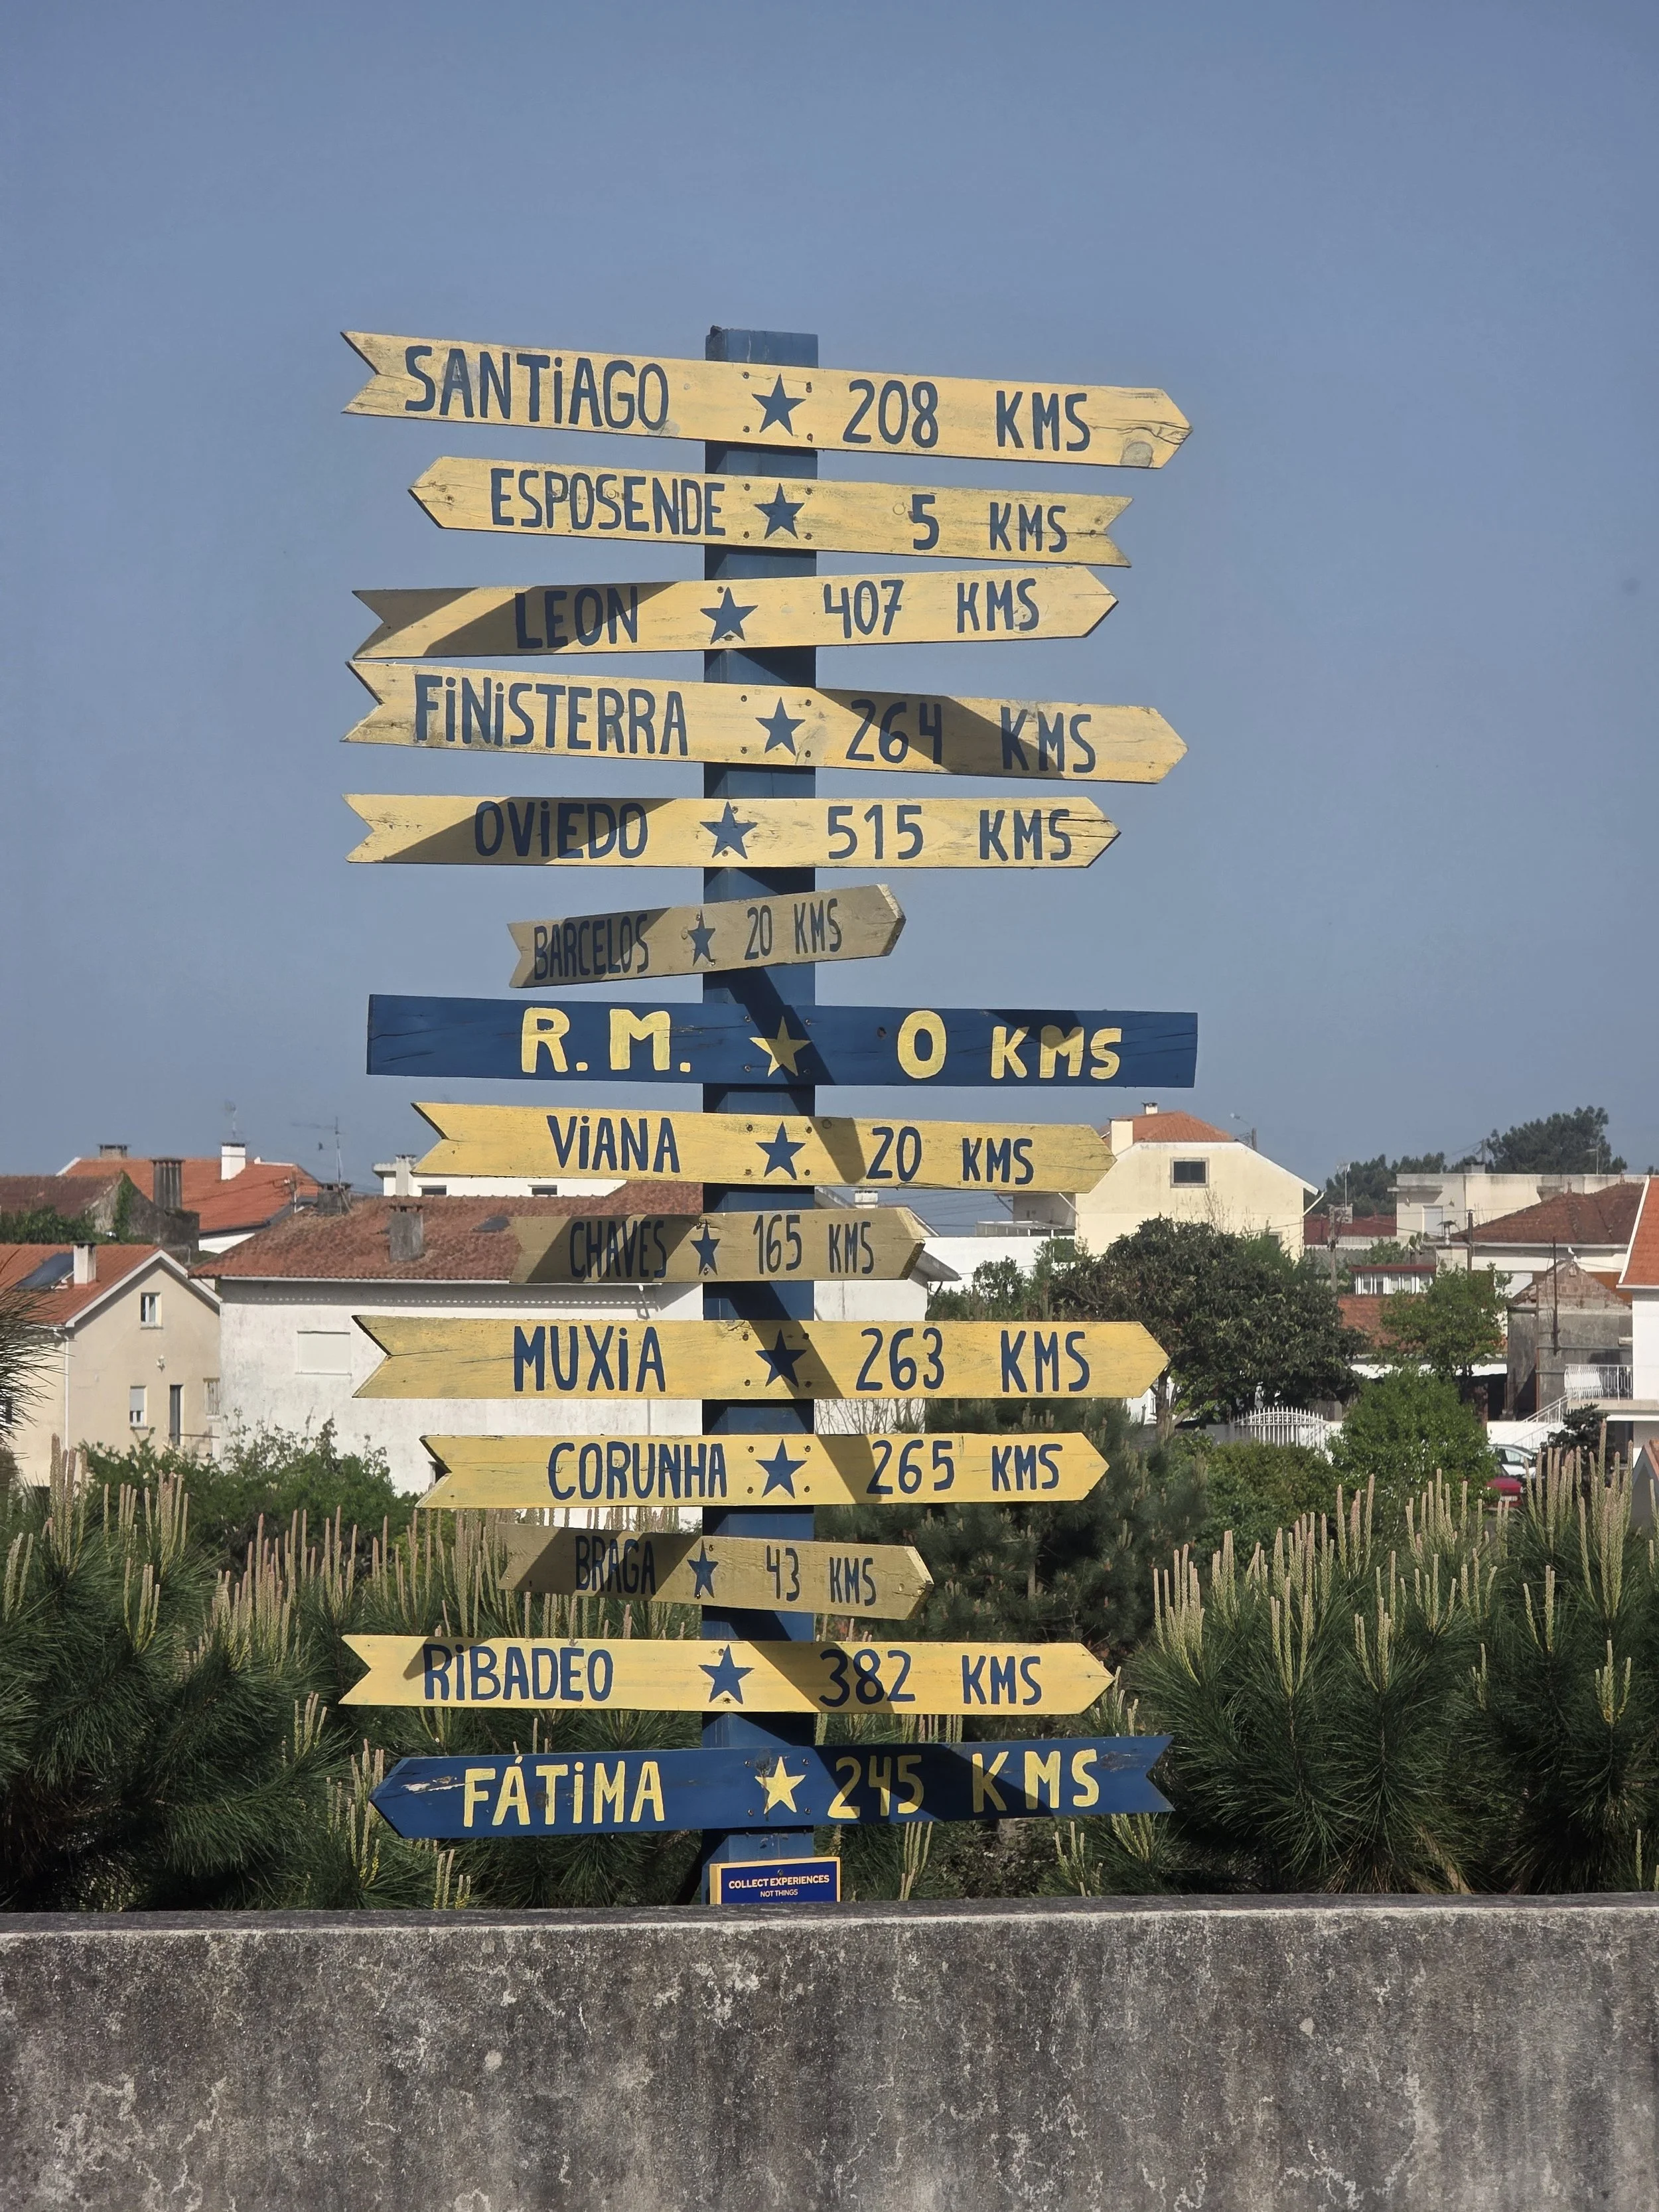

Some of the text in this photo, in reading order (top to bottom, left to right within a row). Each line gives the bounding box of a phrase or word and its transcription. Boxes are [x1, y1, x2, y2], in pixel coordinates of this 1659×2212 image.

[843, 379, 938, 448] 208
[996, 390, 1090, 452] KMS
[490, 468, 1068, 552] ESPOSENDE 5 KMS
[515, 578, 1039, 648] LEON 407 KMS
[845, 699, 942, 764] 264
[1000, 706, 1096, 774] KMS
[828, 804, 924, 860] 515
[979, 809, 1072, 861] KMS
[534, 898, 842, 980] BARCELOS 20 KMS
[866, 1126, 922, 1182] 20
[962, 1138, 1034, 1185] KMS
[569, 1214, 874, 1278] CHAVES 165 KMS
[855, 1327, 944, 1391] 263
[1000, 1330, 1090, 1393] KMS
[548, 1439, 1063, 1500] CORUNHA 265 KMS
[575, 1535, 877, 1606] BRAGA 43 KMS
[818, 1649, 916, 1708] 382
[962, 1655, 1042, 1706] KMS
[828, 1755, 924, 1819] 245
[972, 1749, 1100, 1812] KMS
[729, 1875, 830, 1889] COLLECT EXPERIENCES
